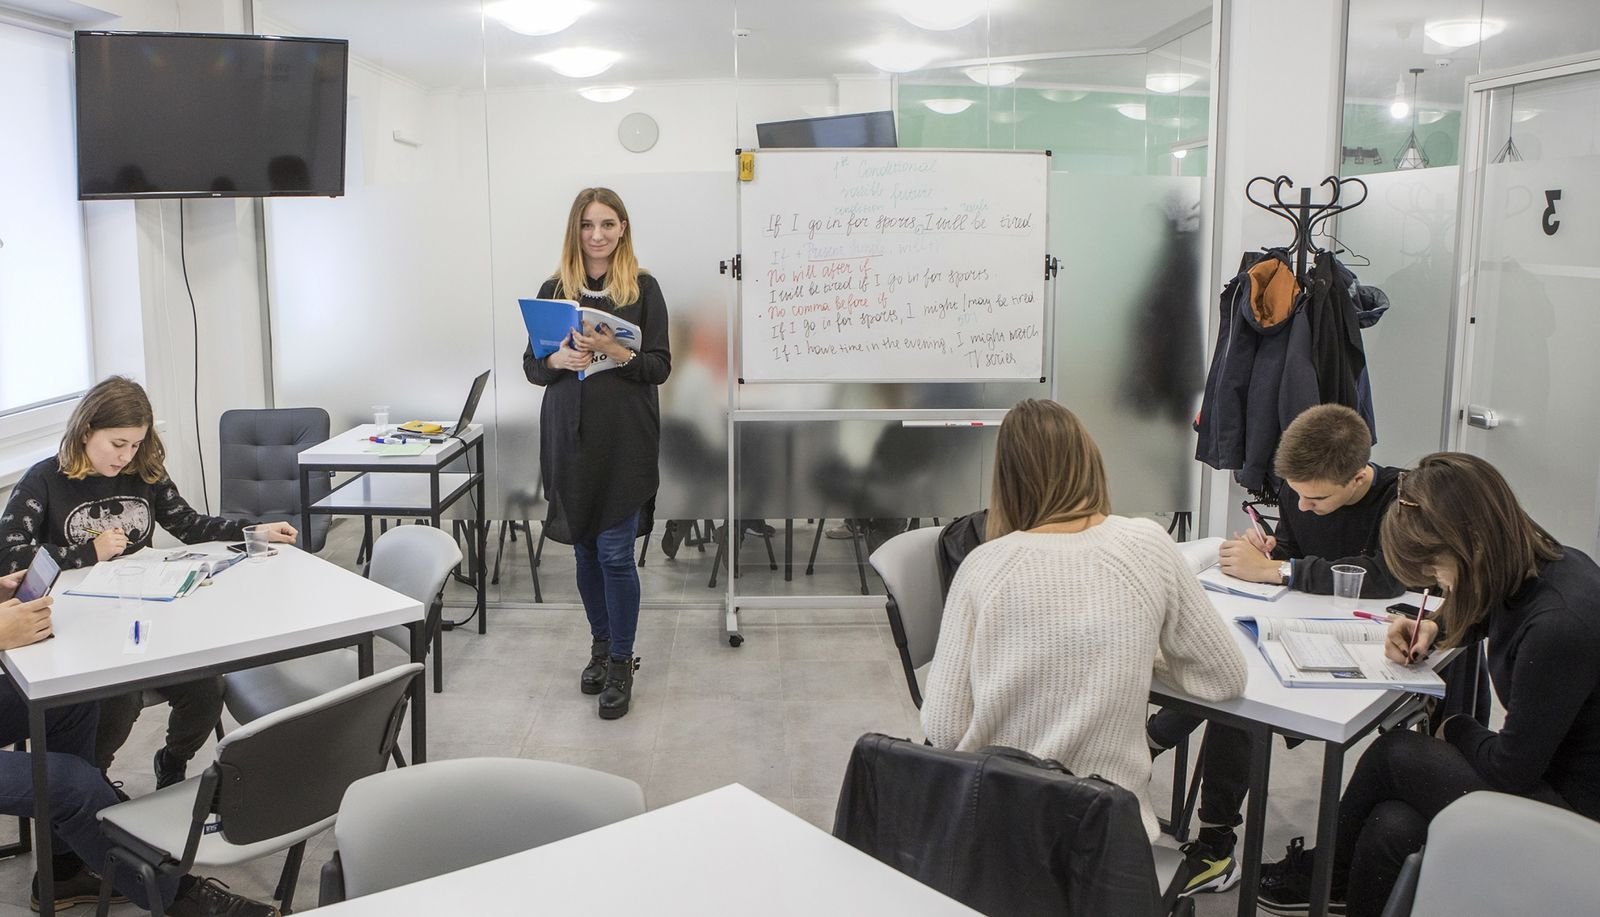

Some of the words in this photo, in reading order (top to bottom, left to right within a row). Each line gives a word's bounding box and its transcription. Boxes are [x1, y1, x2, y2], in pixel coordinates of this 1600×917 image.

[766, 214, 782, 239] If
[792, 213, 799, 231] I
[808, 218, 823, 239] go
[826, 218, 841, 231] in
[846, 214, 868, 236] for
[923, 213, 934, 231] I
[935, 214, 968, 231] will
[971, 211, 986, 230] be
[1000, 213, 1032, 229] tired
[768, 269, 785, 287] No
[793, 265, 816, 283] will
[822, 262, 853, 279] after
[860, 258, 872, 281] if
[769, 290, 777, 303] I
[779, 285, 804, 301] will
[809, 284, 820, 296] be
[824, 276, 852, 293] tired
[859, 276, 869, 293] if
[874, 273, 881, 286] I
[888, 272, 902, 293] go
[908, 271, 919, 283] in
[923, 267, 941, 288] for
[948, 268, 989, 288] sports
[768, 304, 786, 319] No
[792, 302, 830, 317] comma
[835, 295, 869, 314] before
[878, 291, 888, 308] if
[771, 322, 785, 340] If
[789, 321, 796, 334] I
[804, 319, 816, 338] go
[837, 312, 852, 333] for
[906, 302, 916, 319] I
[996, 293, 1008, 307] be
[1011, 291, 1034, 304] tired
[615, 327, 636, 341] 2
[772, 345, 790, 362] If
[795, 344, 802, 355] I
[840, 342, 864, 354] time
[867, 342, 880, 352] in
[882, 336, 899, 349] the
[953, 331, 963, 348] I
[970, 328, 1005, 351] might
[1009, 324, 1039, 341] watch
[964, 349, 980, 369] TV
[986, 350, 1016, 368] series
